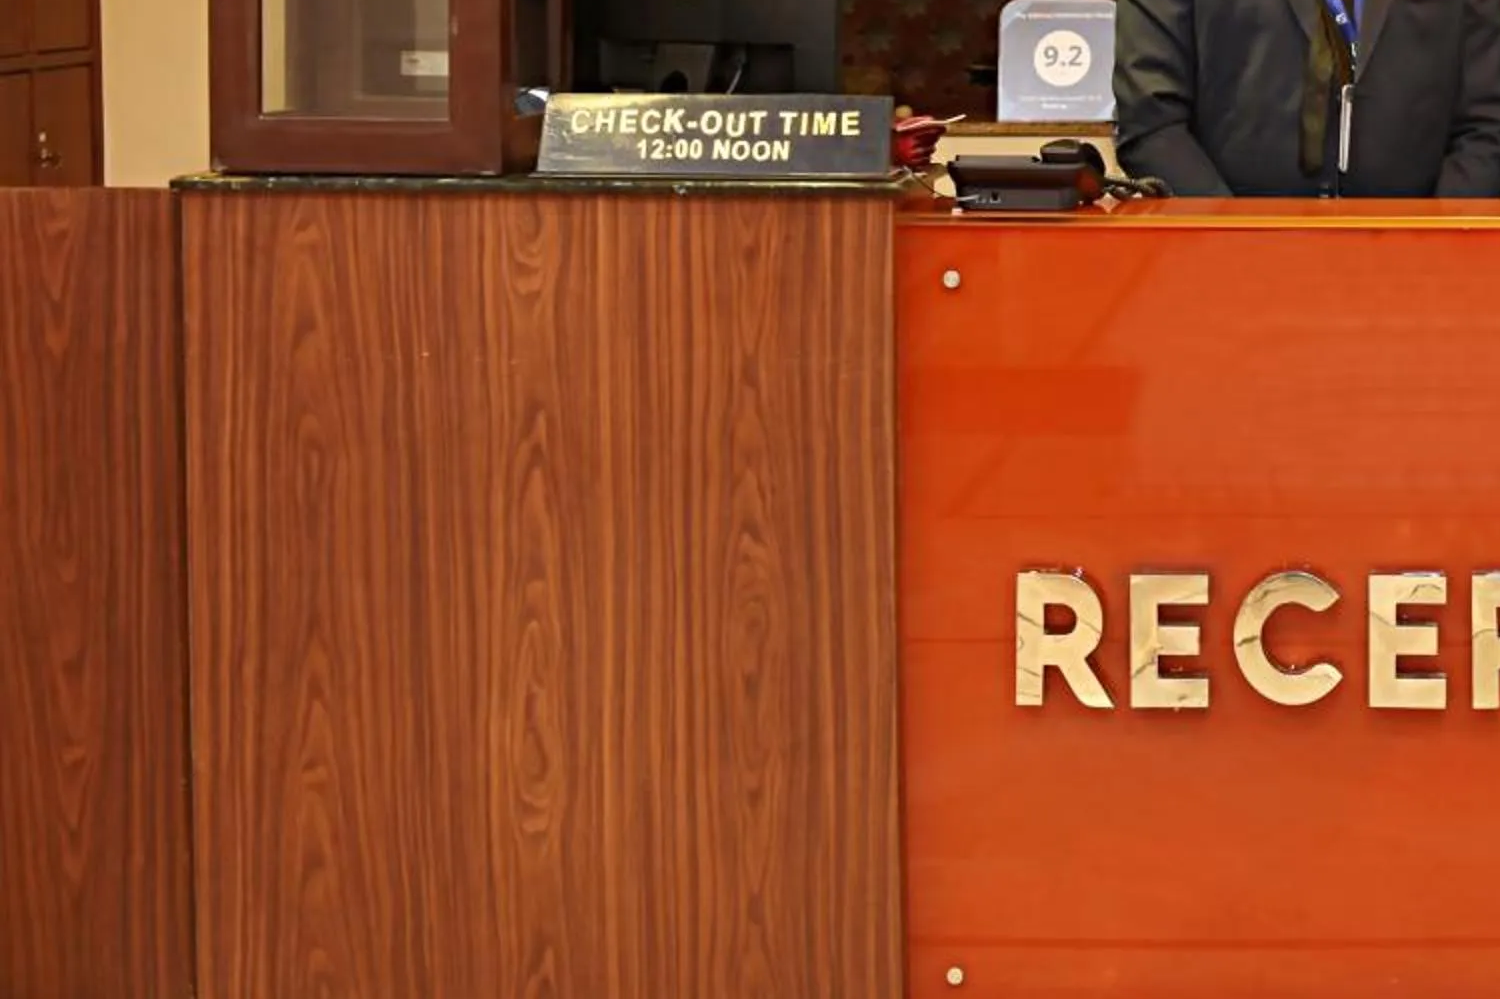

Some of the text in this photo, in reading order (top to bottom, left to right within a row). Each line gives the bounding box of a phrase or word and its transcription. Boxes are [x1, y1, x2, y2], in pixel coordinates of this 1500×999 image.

[1042, 44, 1084, 68] 9.2
[570, 108, 861, 138] CHECK-OUT TIME
[636, 138, 791, 162] 12:00 NOON
